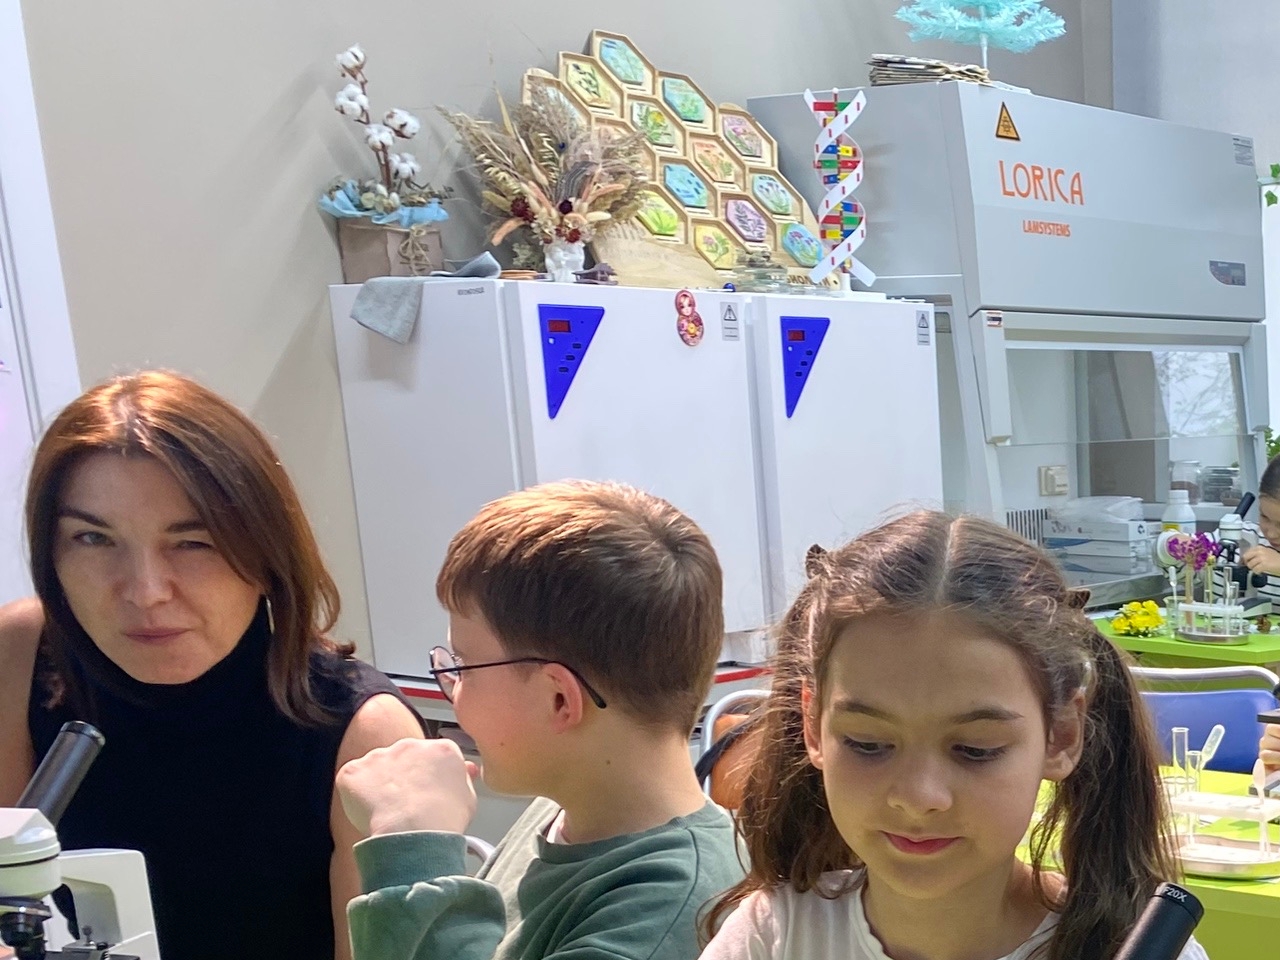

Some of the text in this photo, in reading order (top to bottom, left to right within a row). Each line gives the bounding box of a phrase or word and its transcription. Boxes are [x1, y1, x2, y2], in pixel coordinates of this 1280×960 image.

[998, 160, 1084, 205] LORICA
[1022, 219, 1071, 237] LAMSYSTEMS
[1161, 886, 1188, 902] F20X
